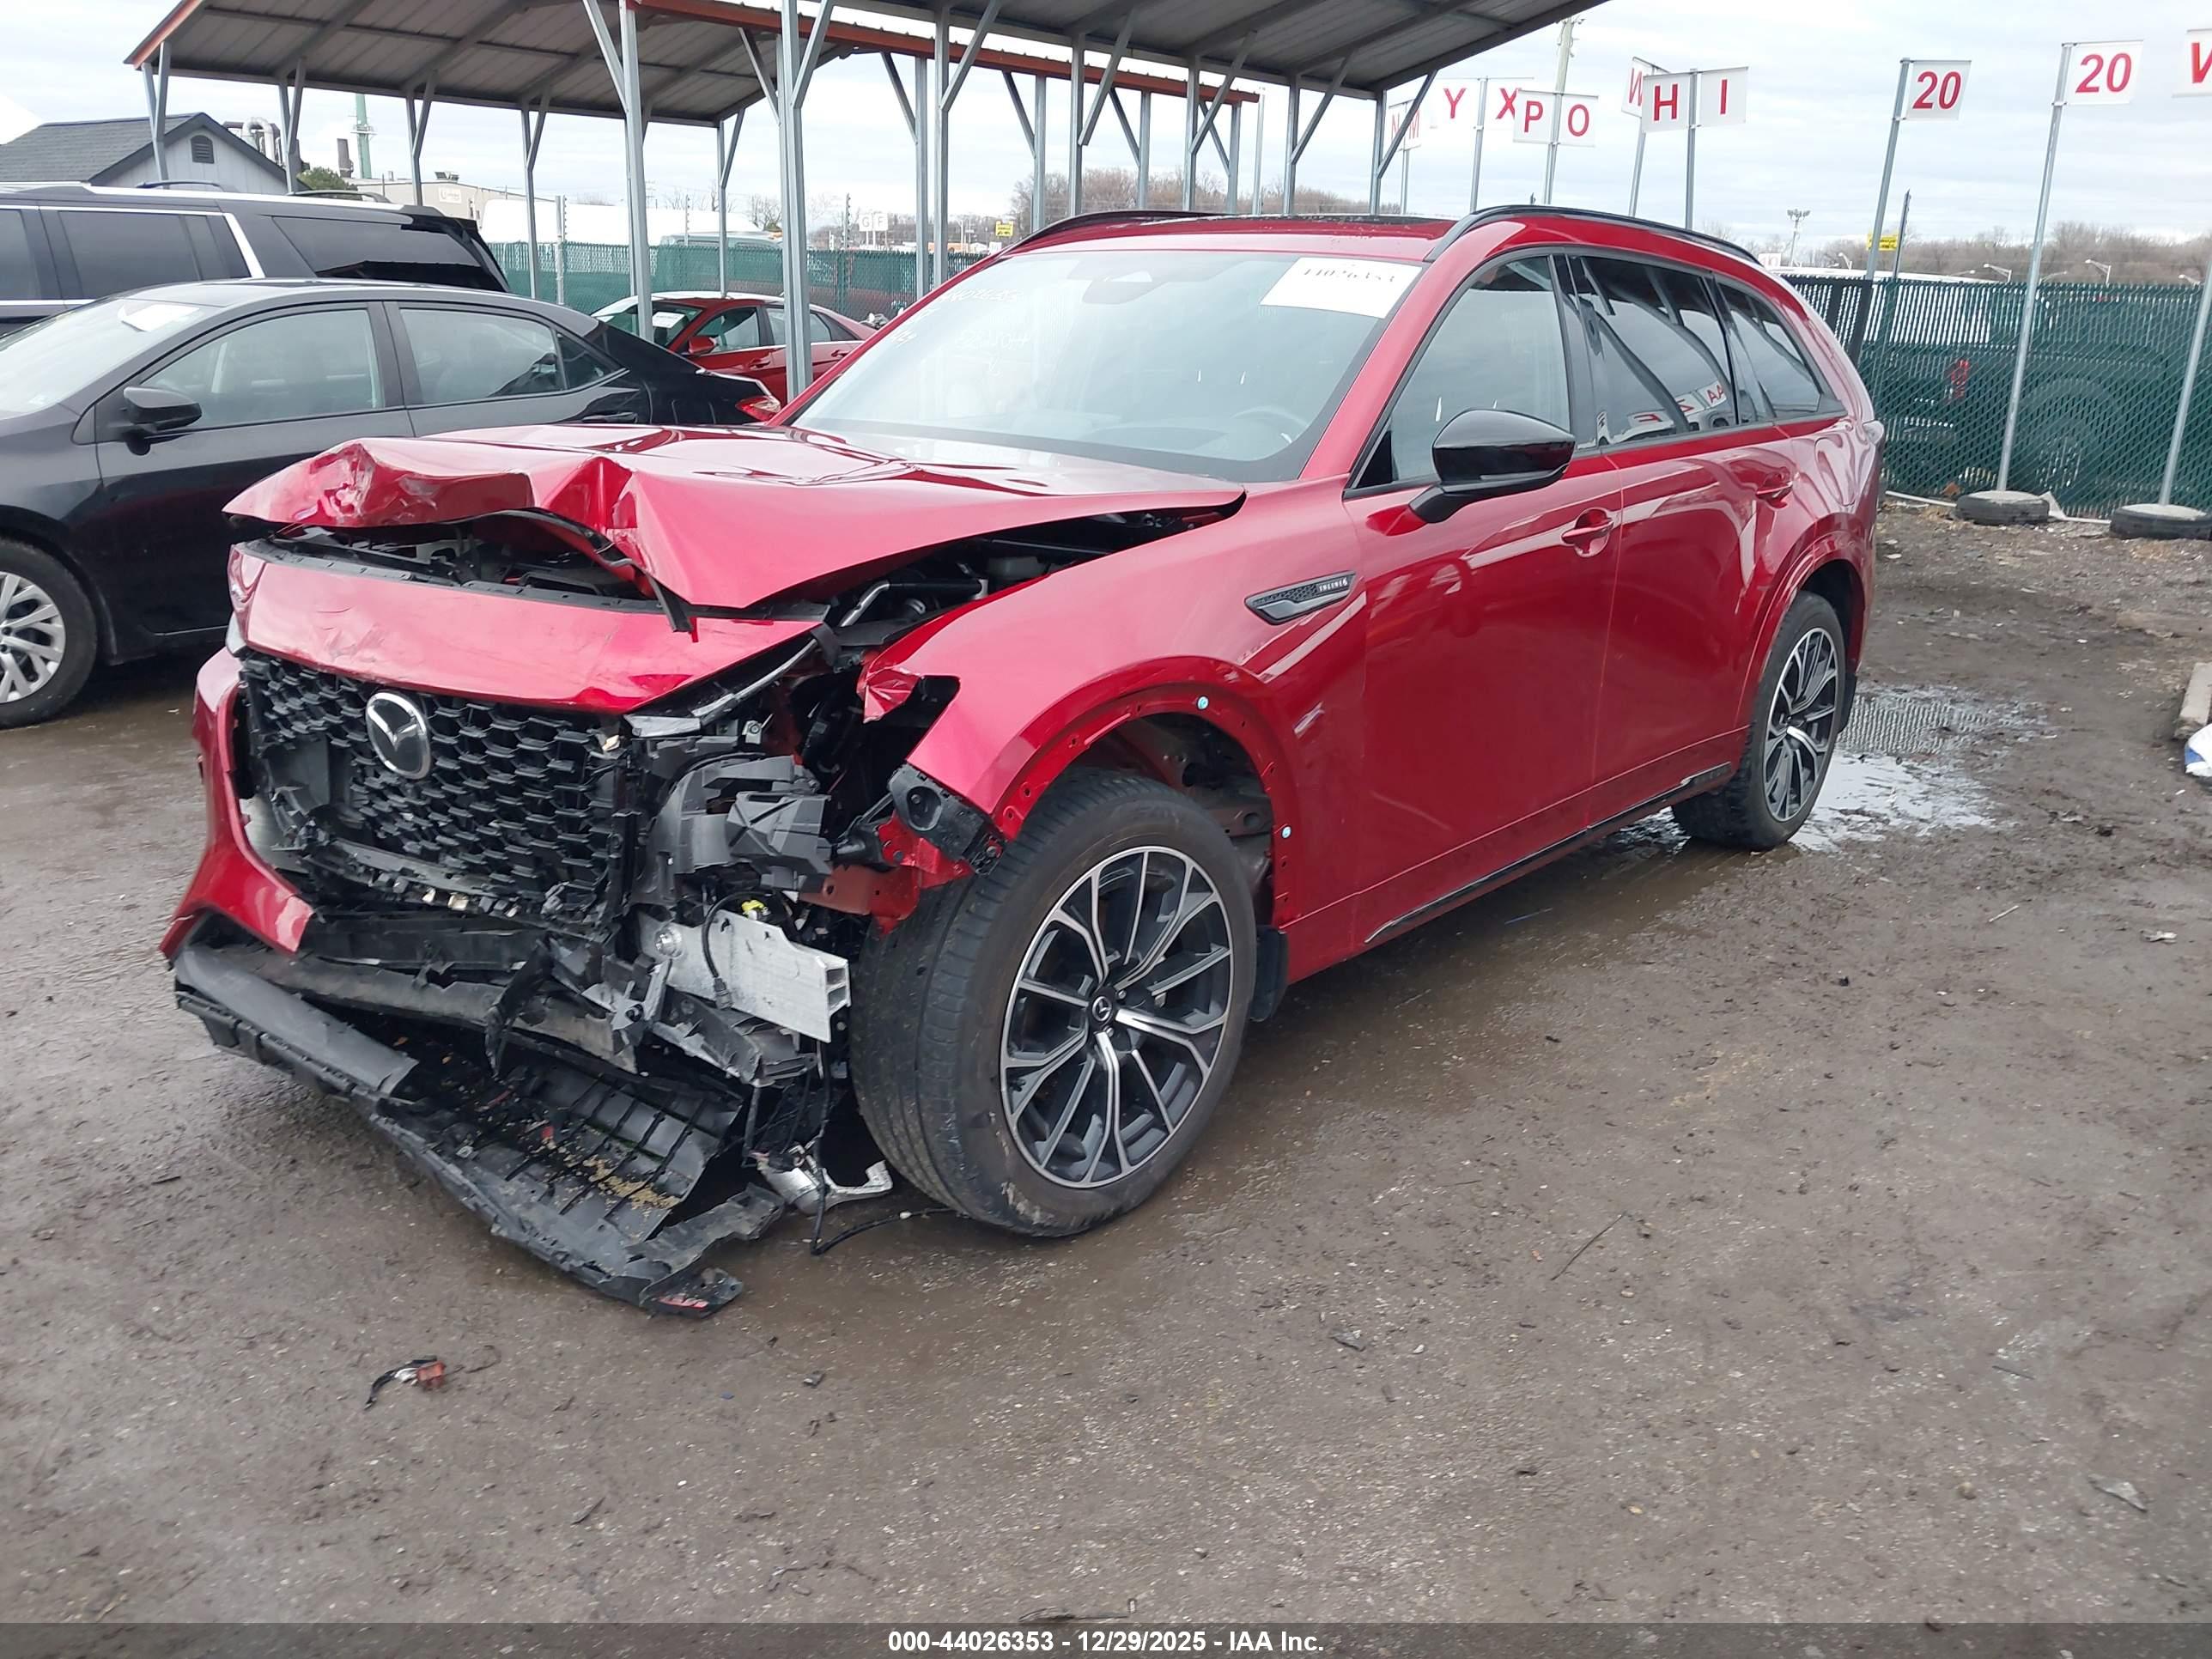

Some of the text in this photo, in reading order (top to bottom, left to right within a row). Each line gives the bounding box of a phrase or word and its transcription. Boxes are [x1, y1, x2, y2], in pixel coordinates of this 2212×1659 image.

[1912, 71, 1963, 110] 20
[2075, 52, 2133, 94] 20
[1443, 88, 1522, 119] Y X
[1524, 100, 1544, 133] P
[1653, 79, 1728, 121] H I
